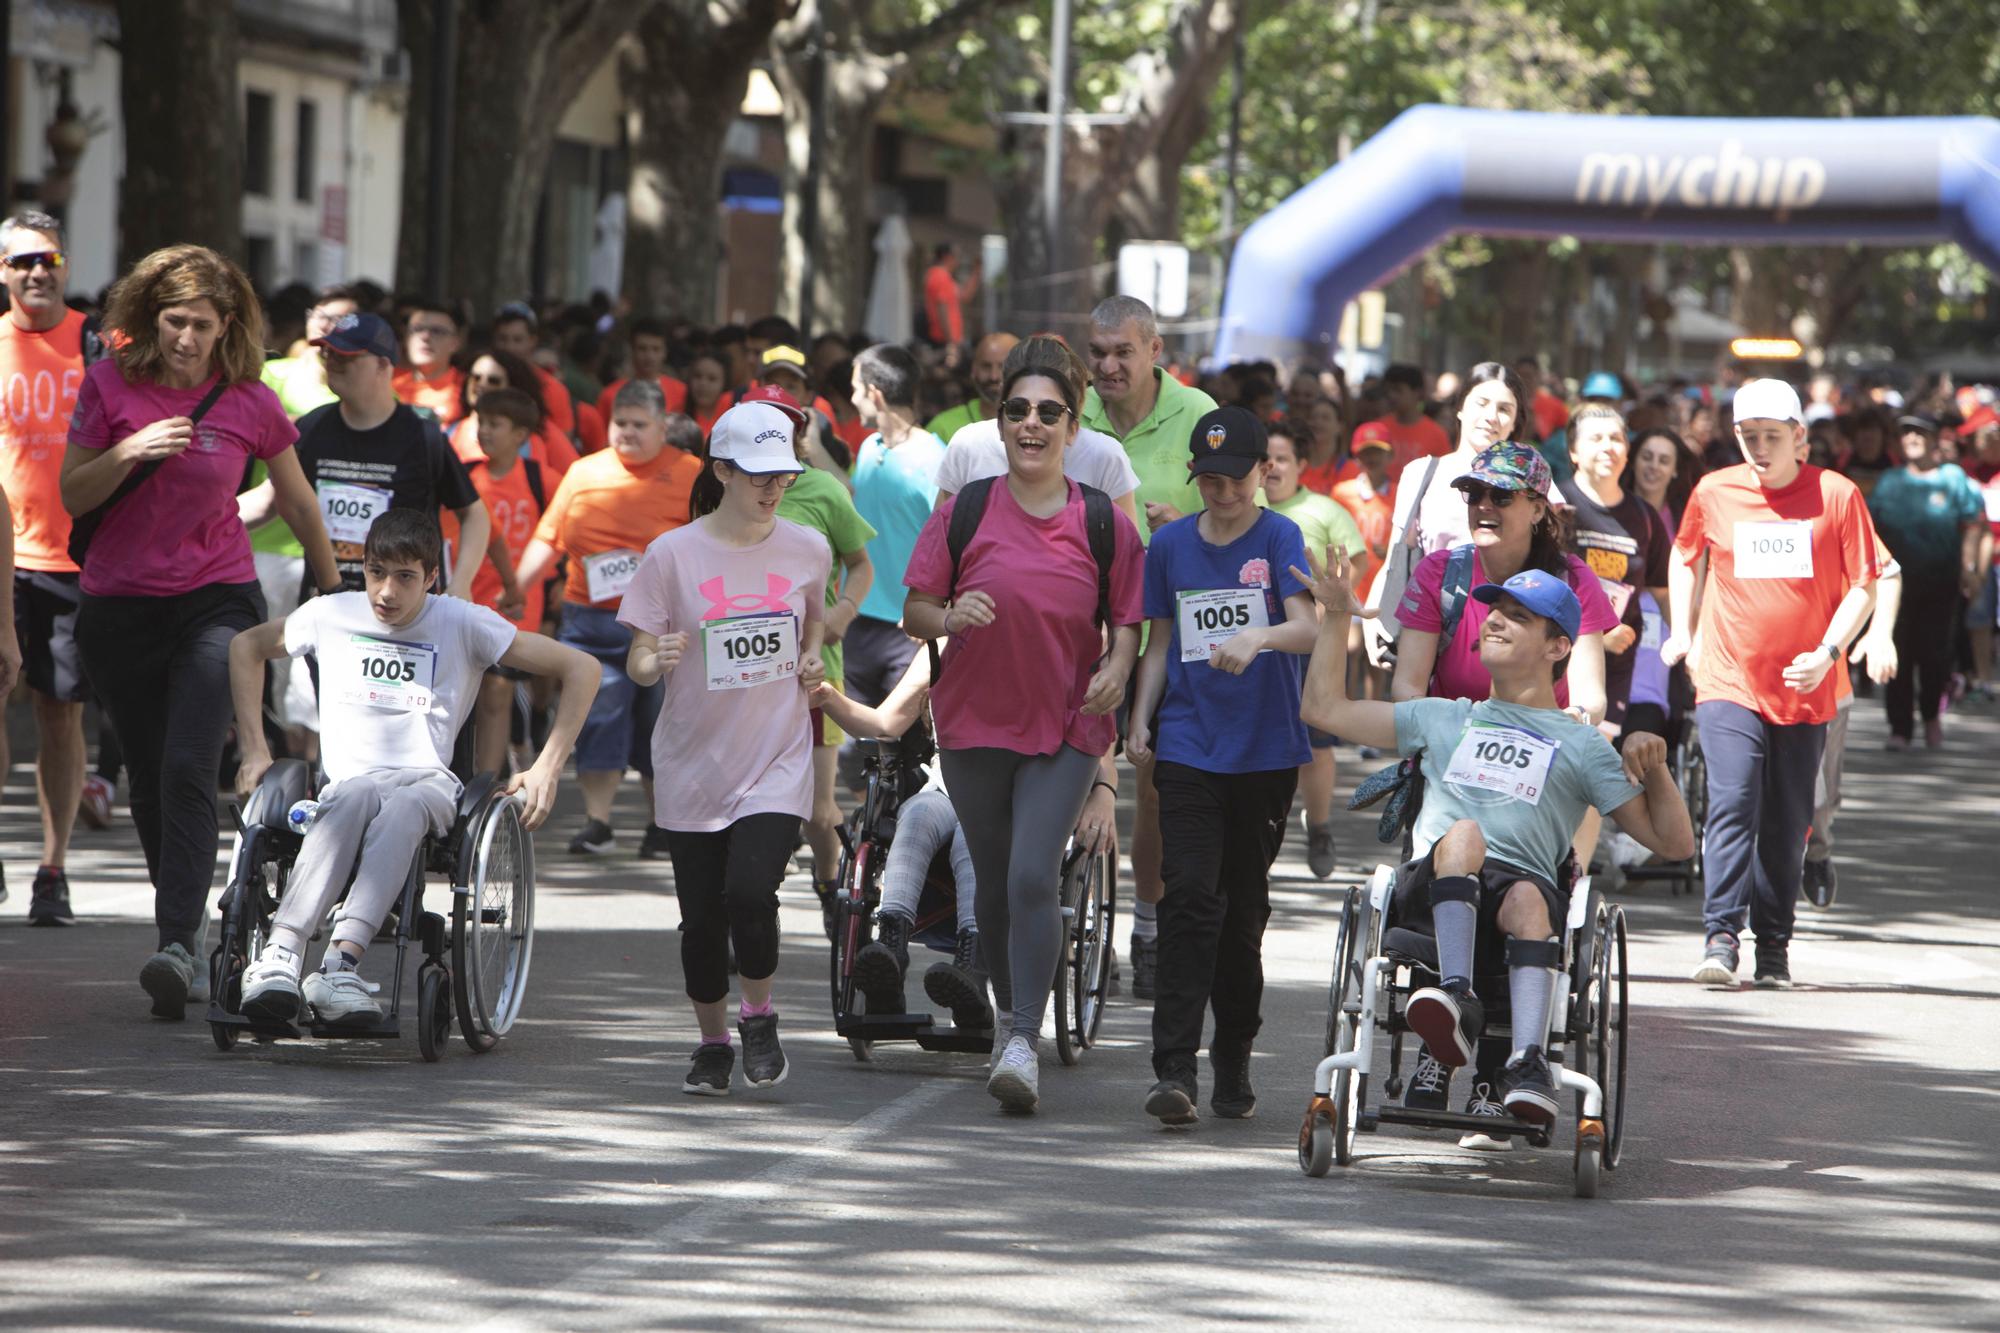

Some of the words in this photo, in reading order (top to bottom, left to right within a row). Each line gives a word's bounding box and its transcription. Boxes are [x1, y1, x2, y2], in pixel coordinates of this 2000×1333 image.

[1575, 138, 1827, 222] mychip
[0, 369, 80, 424] 005
[755, 430, 787, 444] CHICCO
[327, 499, 373, 520] 1005
[1752, 538, 1795, 554] 1005
[600, 556, 638, 578] 1005
[1194, 604, 1250, 631] 1005
[723, 632, 781, 660] 1005
[361, 656, 417, 682] 1005
[1474, 741, 1533, 769] 1005
